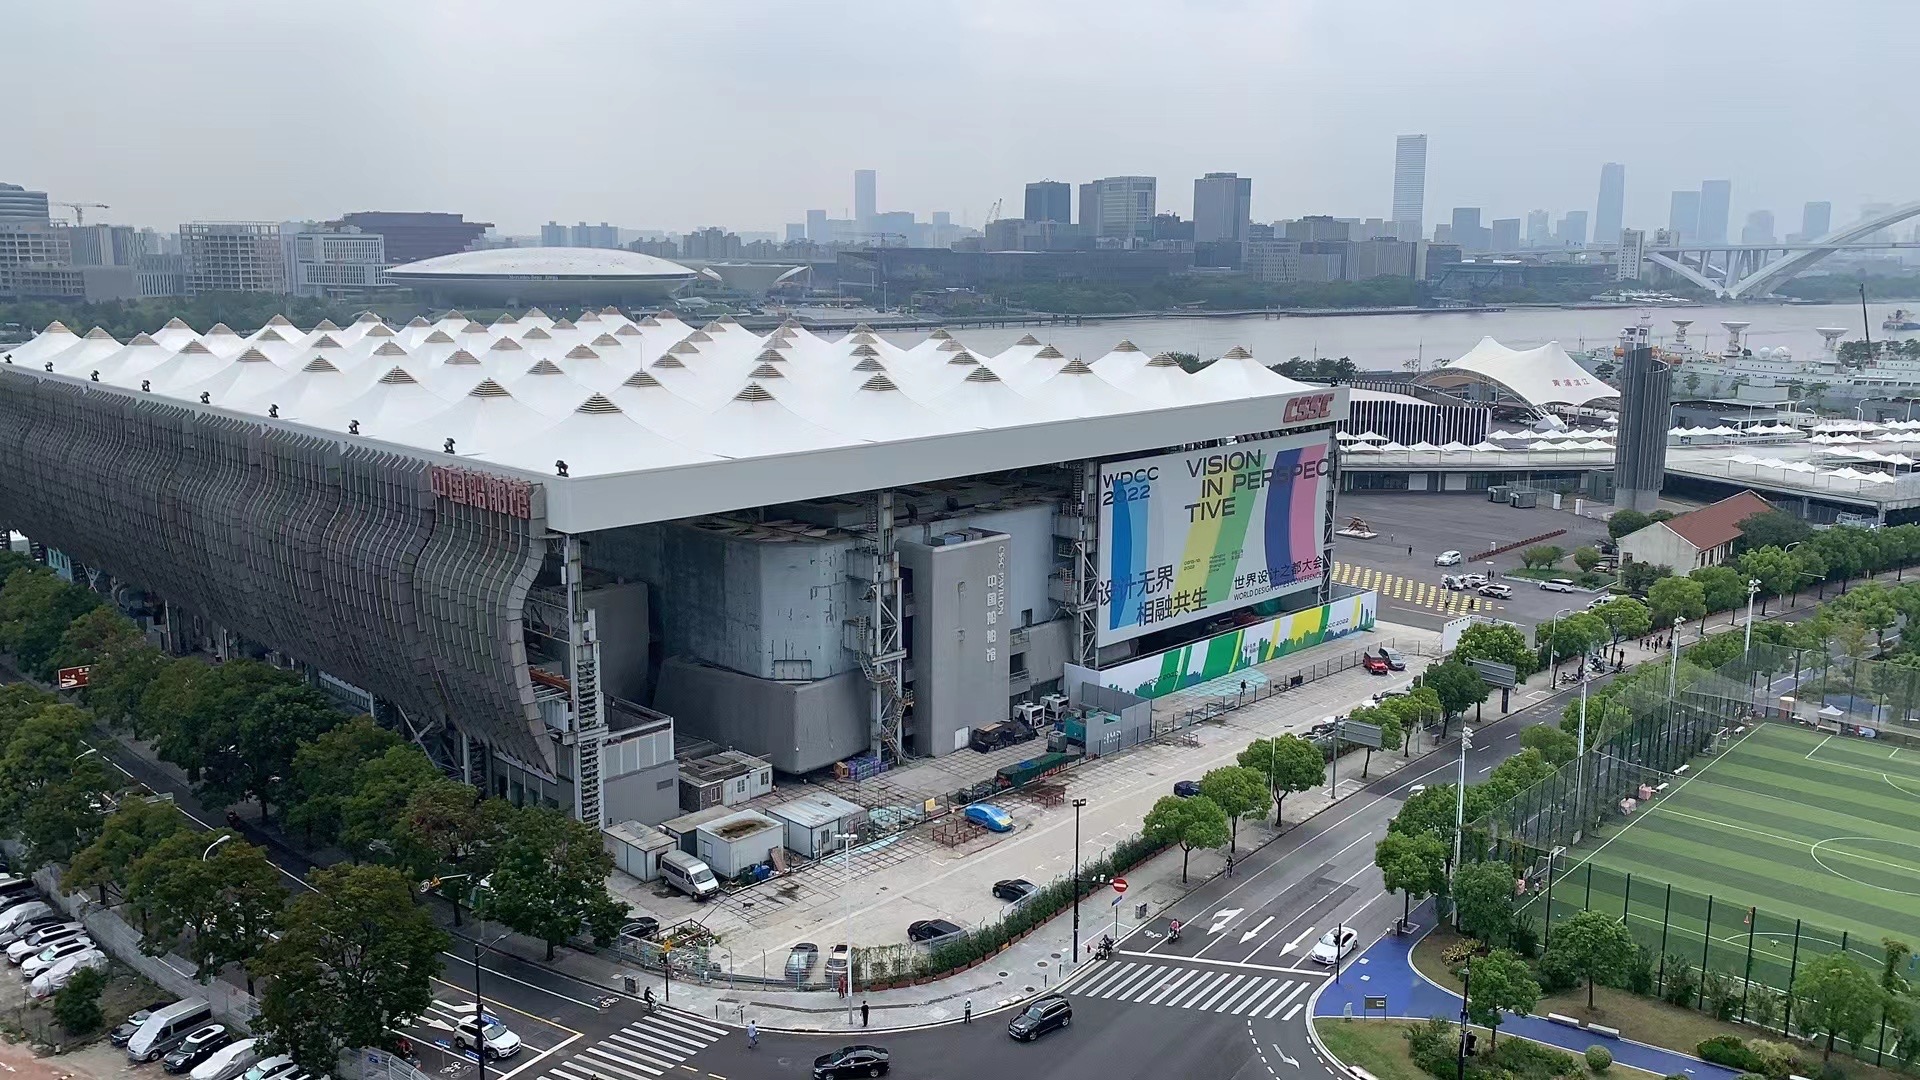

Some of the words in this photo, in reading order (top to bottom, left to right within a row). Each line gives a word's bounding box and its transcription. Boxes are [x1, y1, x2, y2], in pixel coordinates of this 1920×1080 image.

[1283, 393, 1334, 423] CSSC
[1102, 466, 1159, 489] WDCC
[1186, 449, 1261, 478] VISION
[1102, 485, 1151, 506] 2022
[1201, 476, 1223, 498] IN
[1184, 496, 1236, 523] TIVE
[1098, 564, 1174, 606] 设计无界
[1234, 555, 1323, 590] 世界设计之都大会
[997, 572, 1005, 615] PAVILION
[1136, 586, 1208, 627] 相融共生
[1233, 589, 1254, 601] WORLD
[1254, 584, 1273, 596] DESIGN
[986, 574, 997, 662] 中国船舶馆
